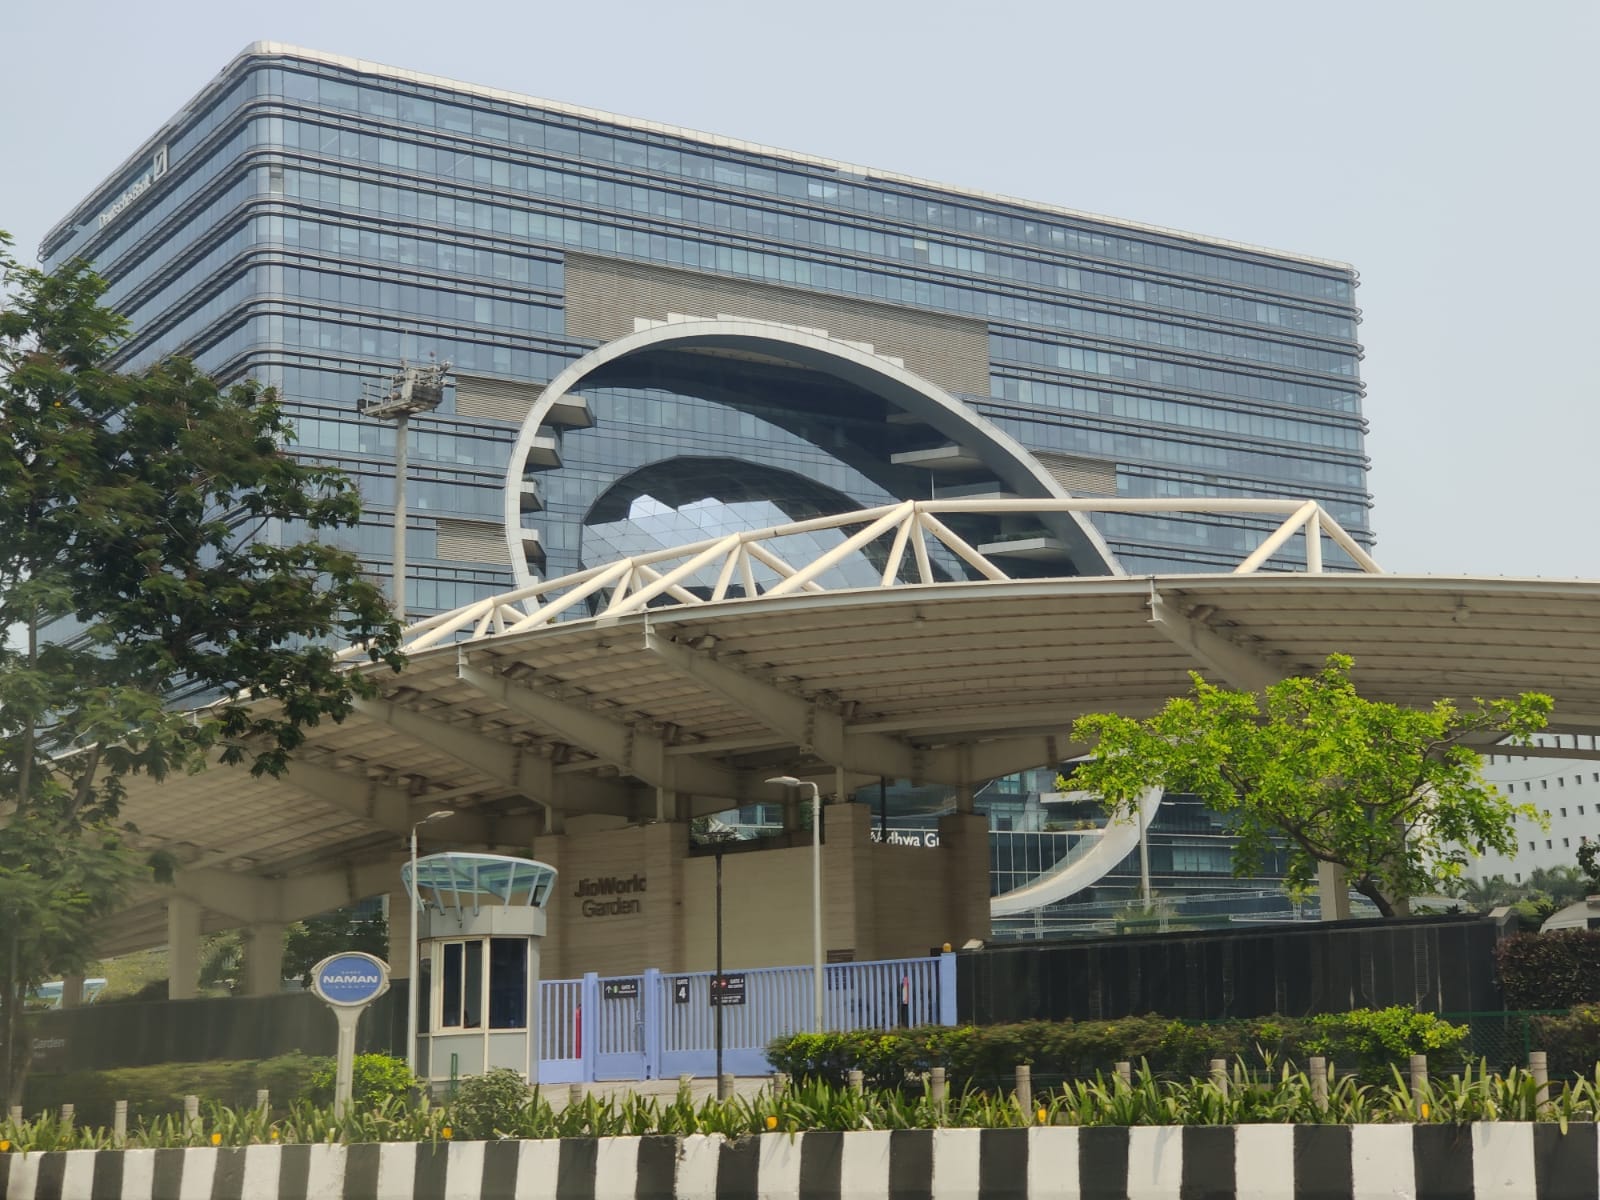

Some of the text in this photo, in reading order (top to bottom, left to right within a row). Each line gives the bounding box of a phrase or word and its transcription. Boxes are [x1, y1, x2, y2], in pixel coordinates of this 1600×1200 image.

[870, 831, 921, 847] Wdhwa
[582, 897, 641, 917] Garden
[323, 975, 378, 984] NAMAN
[678, 986, 687, 999] 4
